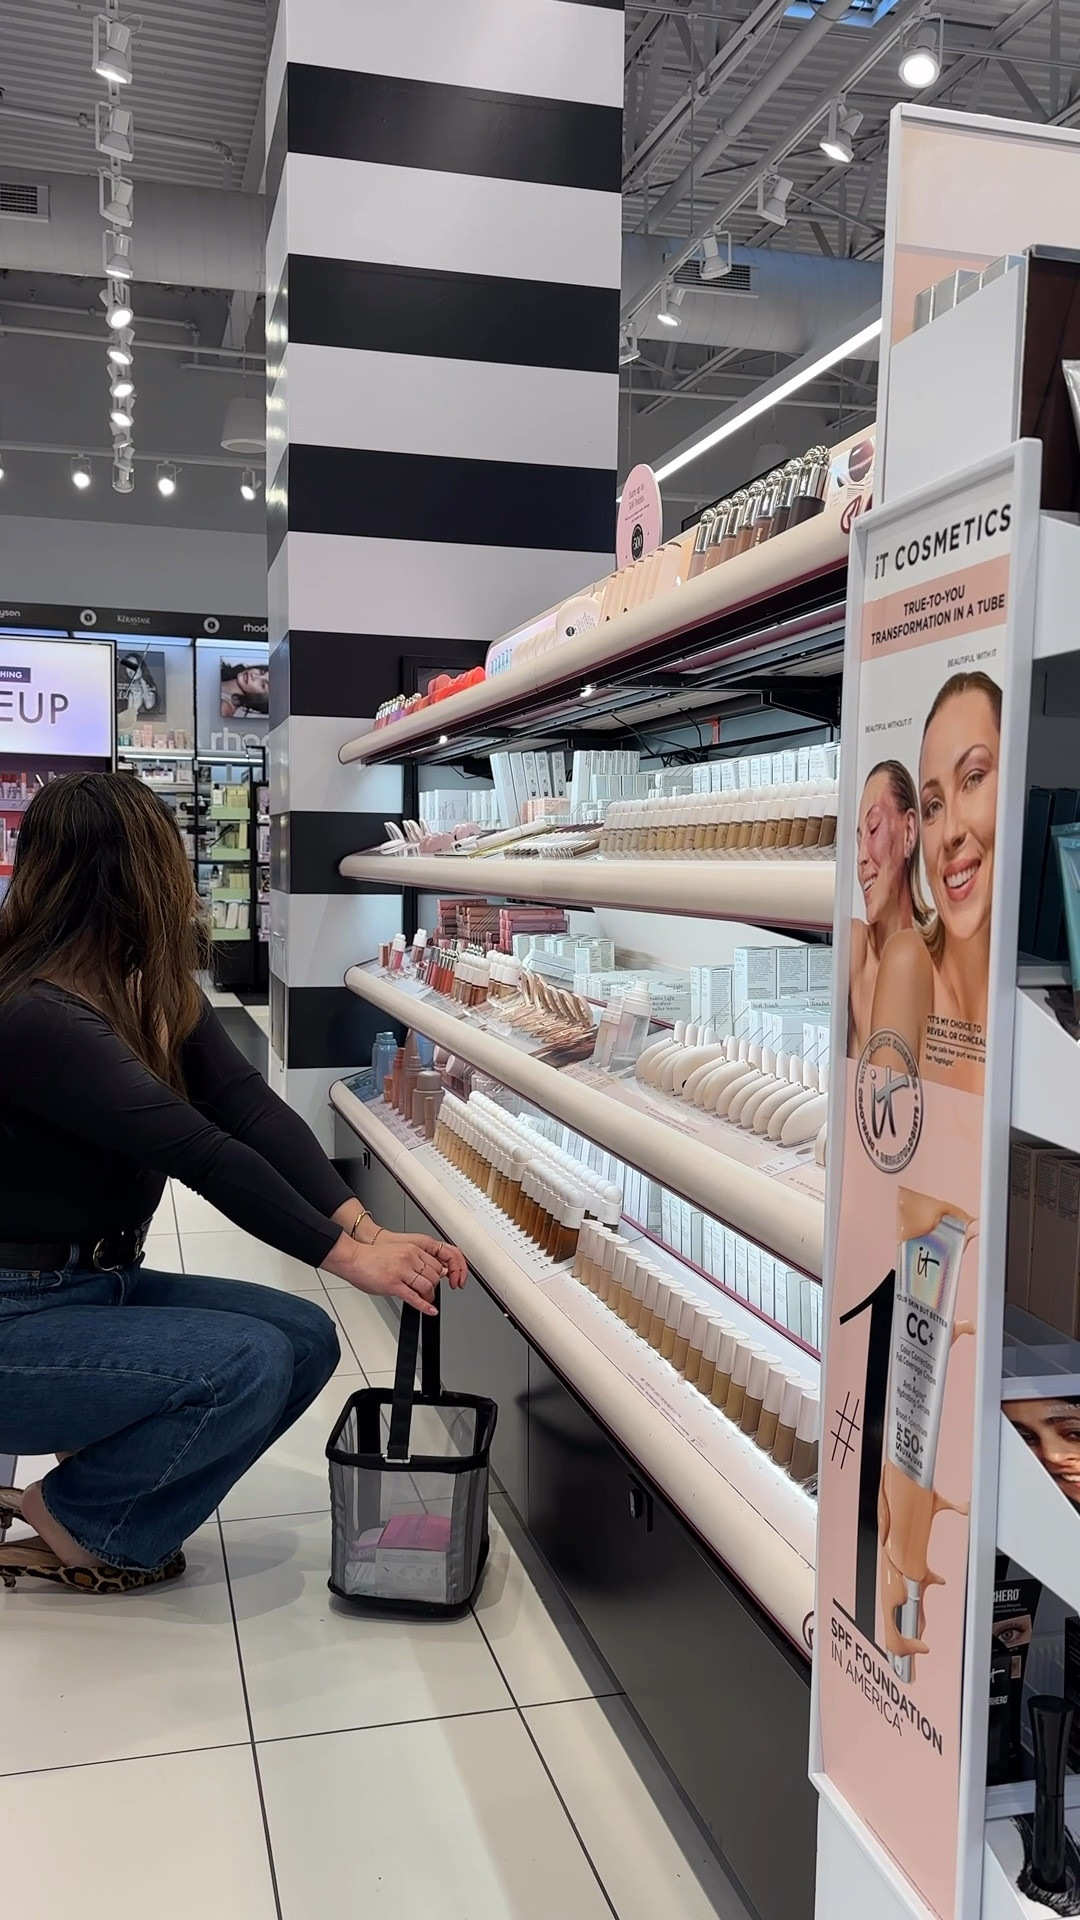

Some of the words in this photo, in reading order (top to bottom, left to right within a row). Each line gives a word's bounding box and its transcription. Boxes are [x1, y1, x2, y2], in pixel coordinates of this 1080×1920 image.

[895, 503, 1012, 571] COSMETICS
[904, 584, 965, 617] TRUE-TO-YOU
[871, 610, 951, 645] TRANSFORMATION
[953, 605, 964, 622] IN
[966, 603, 974, 618] A
[977, 594, 1006, 615] TUBE
[947, 654, 975, 668] BEAUTIFUL
[976, 651, 990, 660] WITH
[991, 648, 997, 657] IT
[865, 722, 886, 734] BEAUTIFUL
[887, 718, 907, 728] WITHOUT
[927, 1026, 948, 1038] REVEAL
[949, 1031, 957, 1040] OR
[958, 1033, 986, 1047] CONCEAL
[940, 1018, 949, 1026] MY
[950, 1020, 972, 1031] CHOICE
[973, 1024, 982, 1033] TO
[926, 1042, 938, 1052] Paige
[956, 1051, 966, 1059] port
[918, 1246, 940, 1278] it
[896, 1294, 908, 1304] YOUR
[908, 1299, 919, 1310] SKIN
[920, 1306, 929, 1316] BUT
[930, 1311, 948, 1328] BETTER
[906, 1312, 934, 1346] CC+
[900, 1344, 911, 1356] Color
[911, 1350, 933, 1374] Correcting
[831, 1640, 843, 1668] IN
[831, 1617, 852, 1650] SPF
[855, 1642, 942, 1756] FOUNDATION
